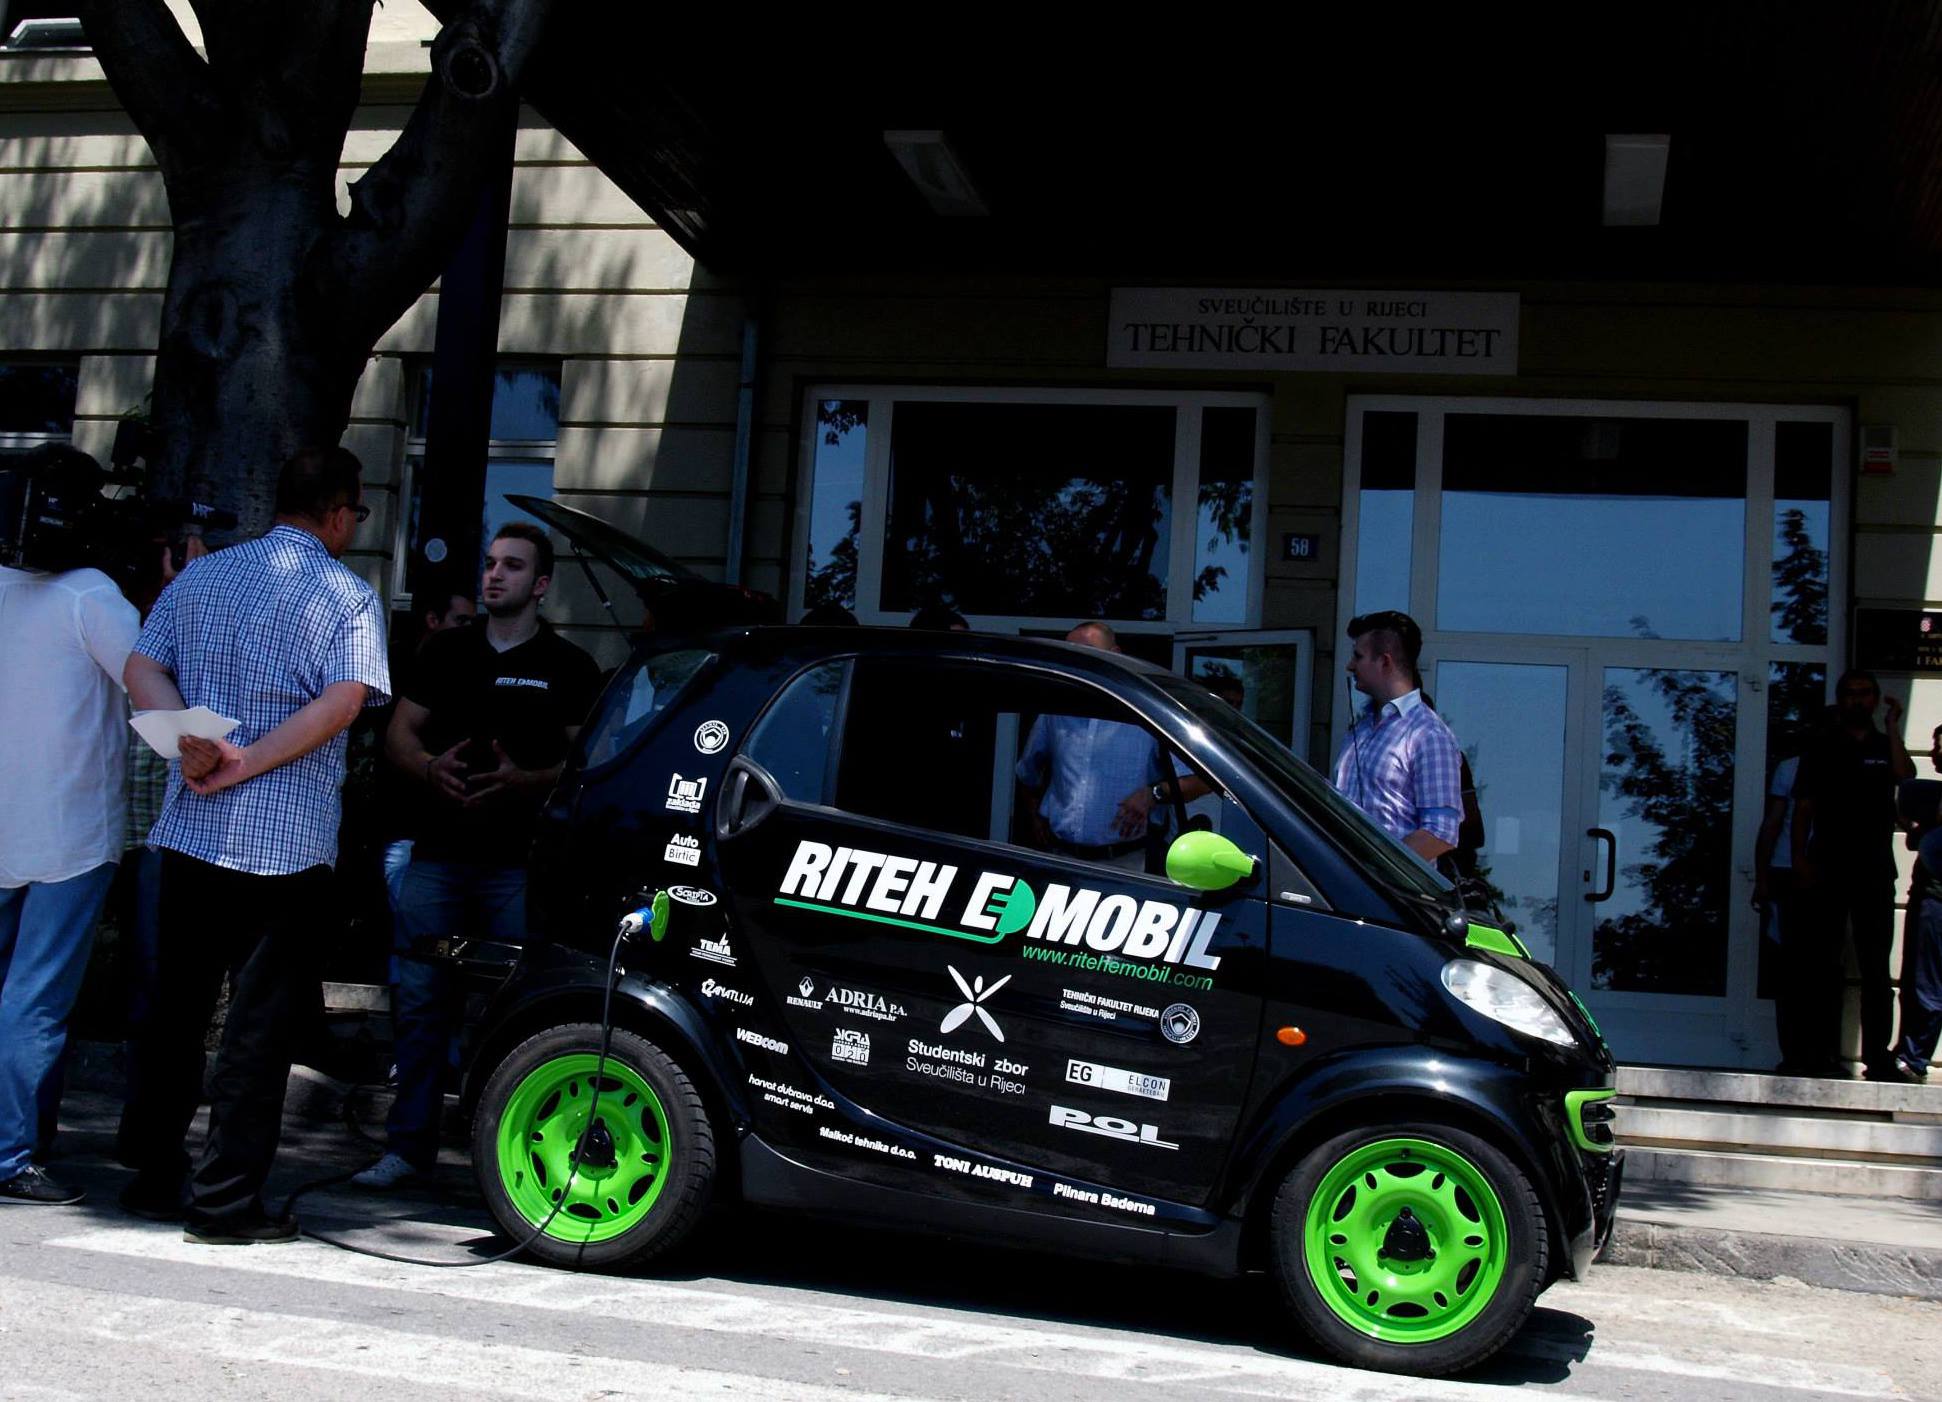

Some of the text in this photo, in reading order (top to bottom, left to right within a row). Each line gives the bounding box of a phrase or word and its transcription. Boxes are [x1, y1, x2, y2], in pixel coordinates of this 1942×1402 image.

[1198, 296, 1427, 318] SVEUČILIŠTE U RIJECI
[1124, 317, 1501, 358] TEHNIČKI FAKULTET
[671, 832, 699, 848] Auto
[779, 840, 958, 920] RITEH
[1022, 945, 1214, 991] www.ritehemobil.com
[786, 995, 823, 1010] RENAULT
[825, 986, 888, 1013] ADRIA
[1096, 996, 1134, 1013] FAKULTET
[1133, 1004, 1160, 1019] RIJEKA
[843, 1006, 897, 1022] www.adriapa.hr
[907, 1038, 1029, 1076] Studentski zbor
[906, 1056, 1026, 1095] Sveučilišta u Rijeci
[1069, 1063, 1093, 1082] EG
[1128, 1074, 1166, 1092] ELCON
[748, 1073, 777, 1091] horvat
[777, 1083, 813, 1103] dubrava
[764, 1093, 814, 1115] smart servis
[854, 1136, 889, 1153] tehnika
[934, 1155, 1034, 1188] TONI AUSPUH
